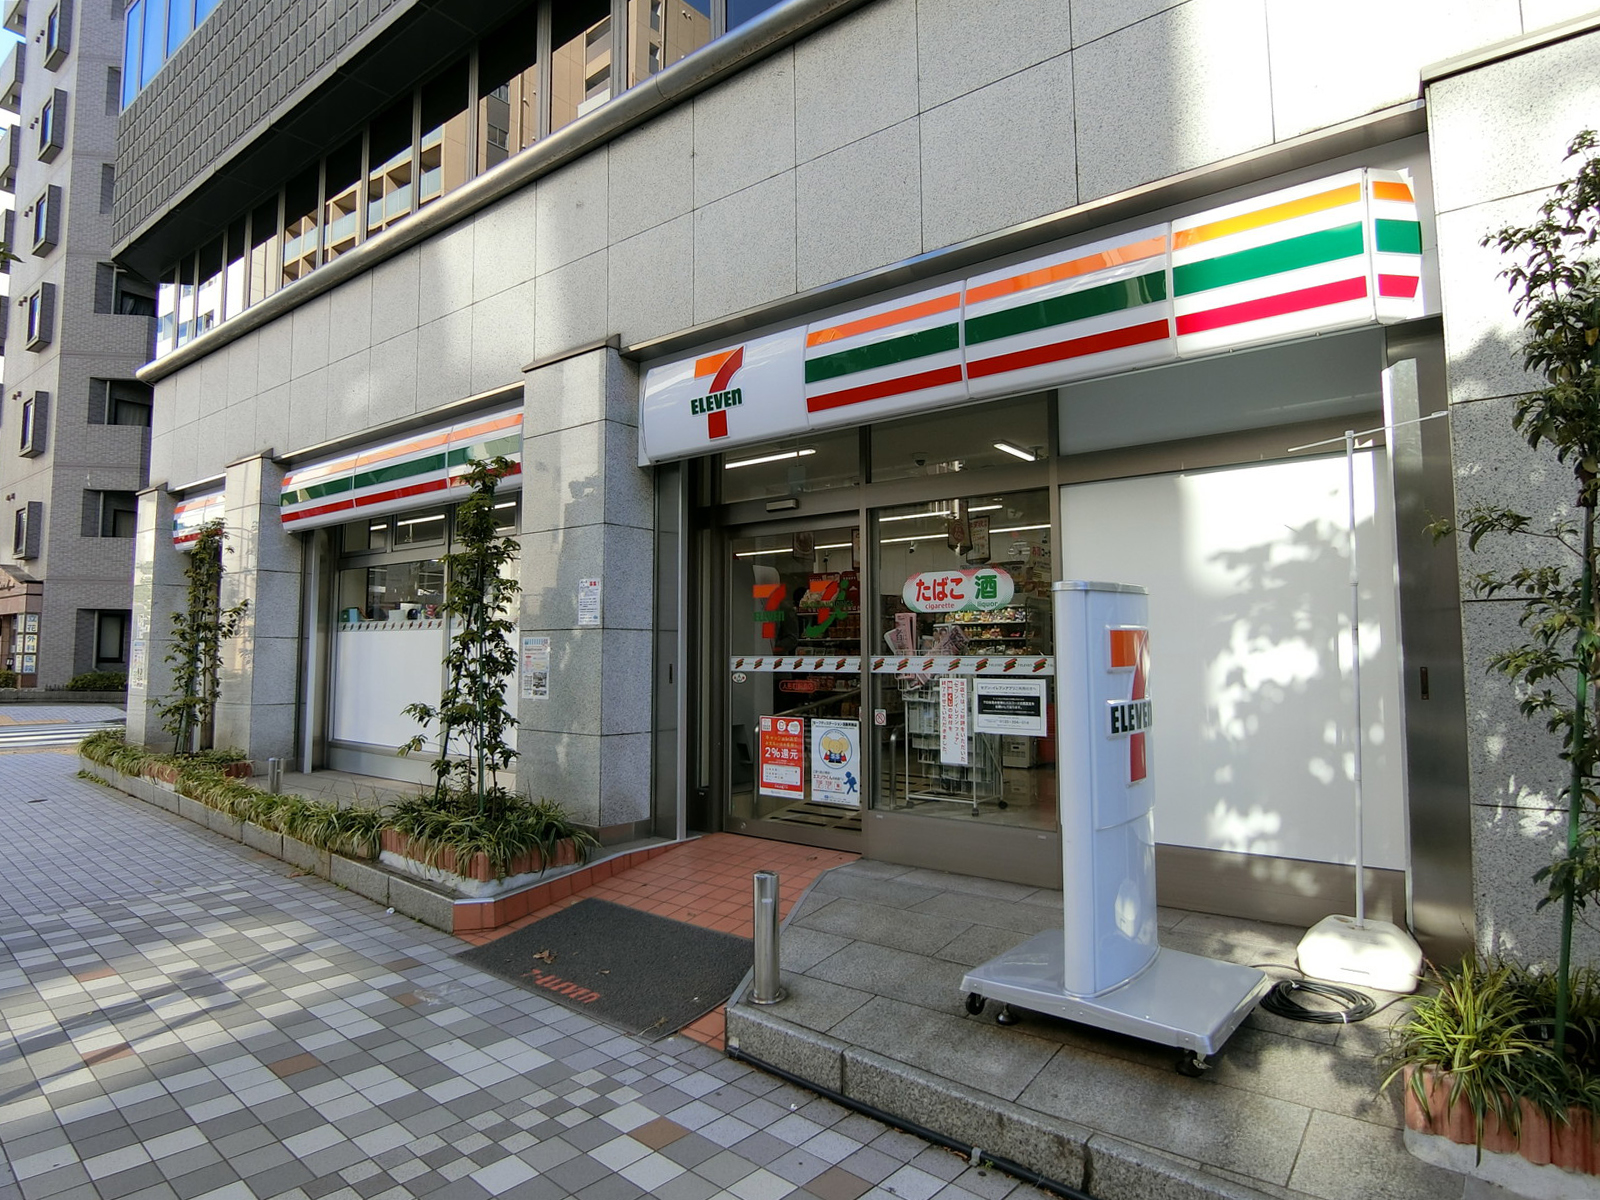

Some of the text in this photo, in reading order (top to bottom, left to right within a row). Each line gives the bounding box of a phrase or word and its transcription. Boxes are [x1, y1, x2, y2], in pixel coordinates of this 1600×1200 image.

[694, 346, 744, 439] 7
[915, 576, 965, 602] たばこ
[974, 574, 998, 600] 酒
[925, 602, 955, 610] cigarette
[976, 600, 998, 608] liquor
[764, 747, 799, 760] 2%還元
